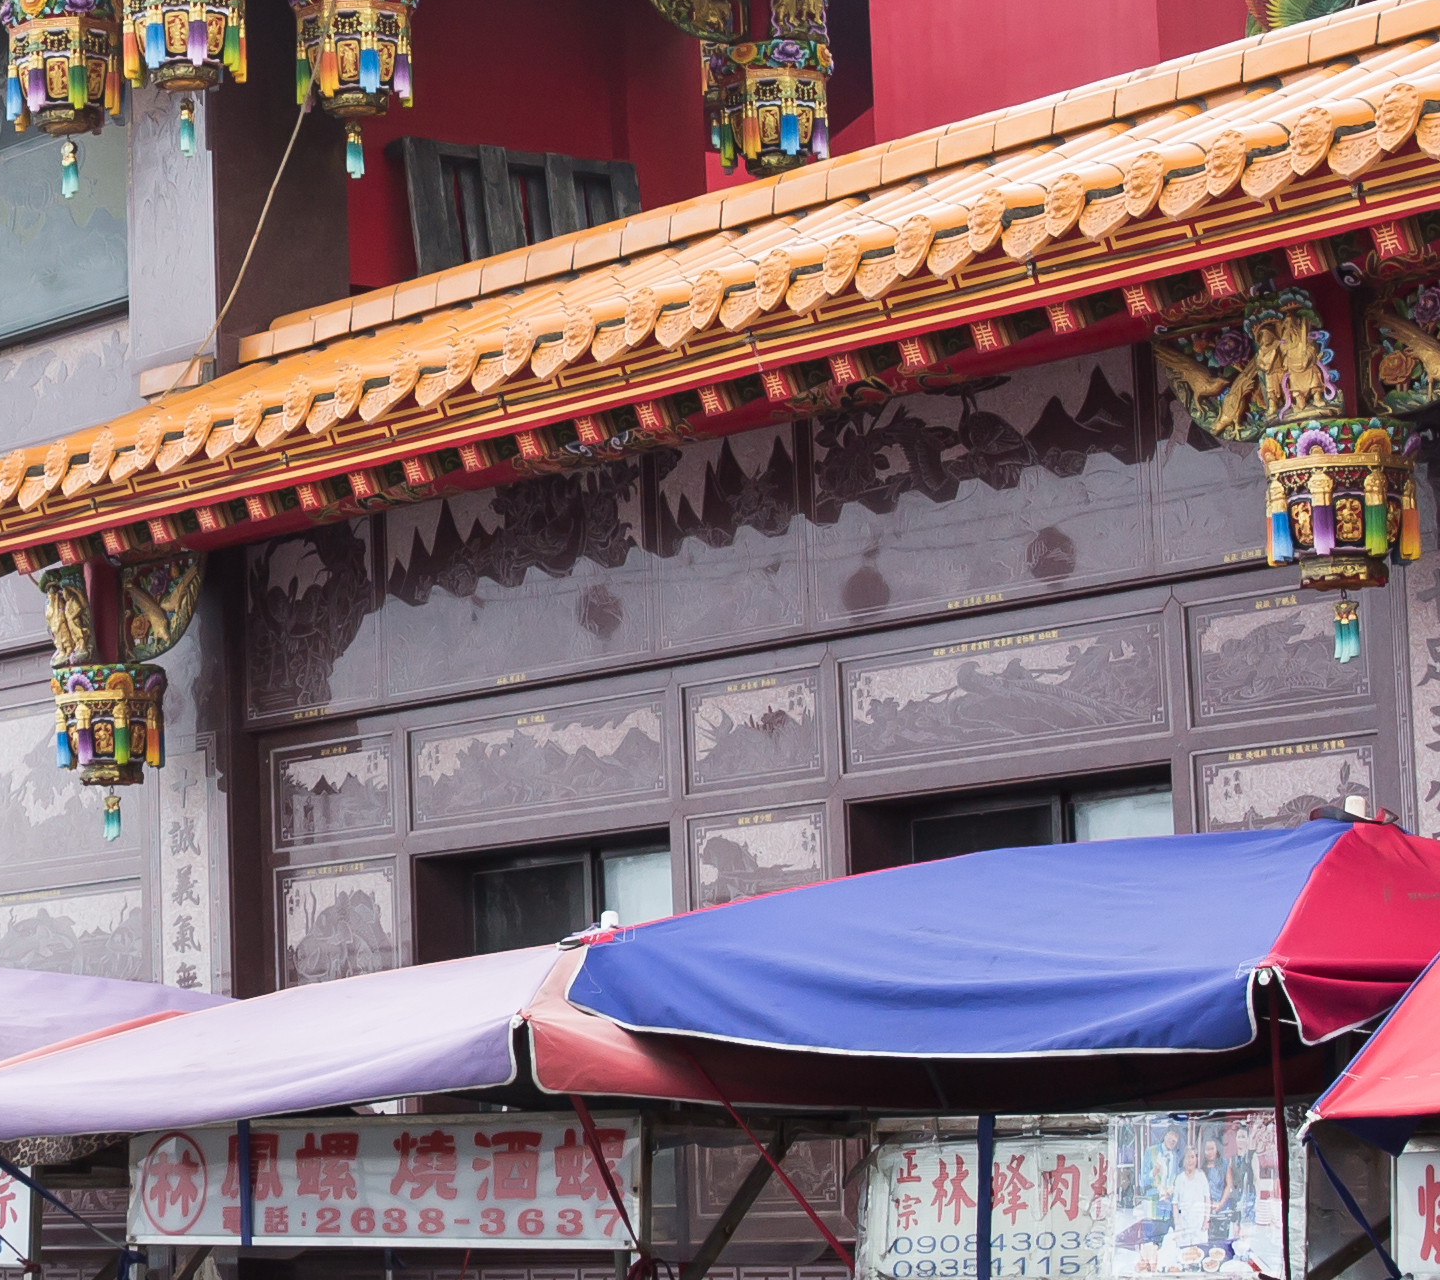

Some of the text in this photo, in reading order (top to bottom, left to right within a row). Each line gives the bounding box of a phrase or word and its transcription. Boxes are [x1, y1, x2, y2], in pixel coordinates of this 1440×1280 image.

[146, 1128, 628, 1223] 林 鳳螺 燒酒螺
[895, 1149, 922, 1230] 正宗
